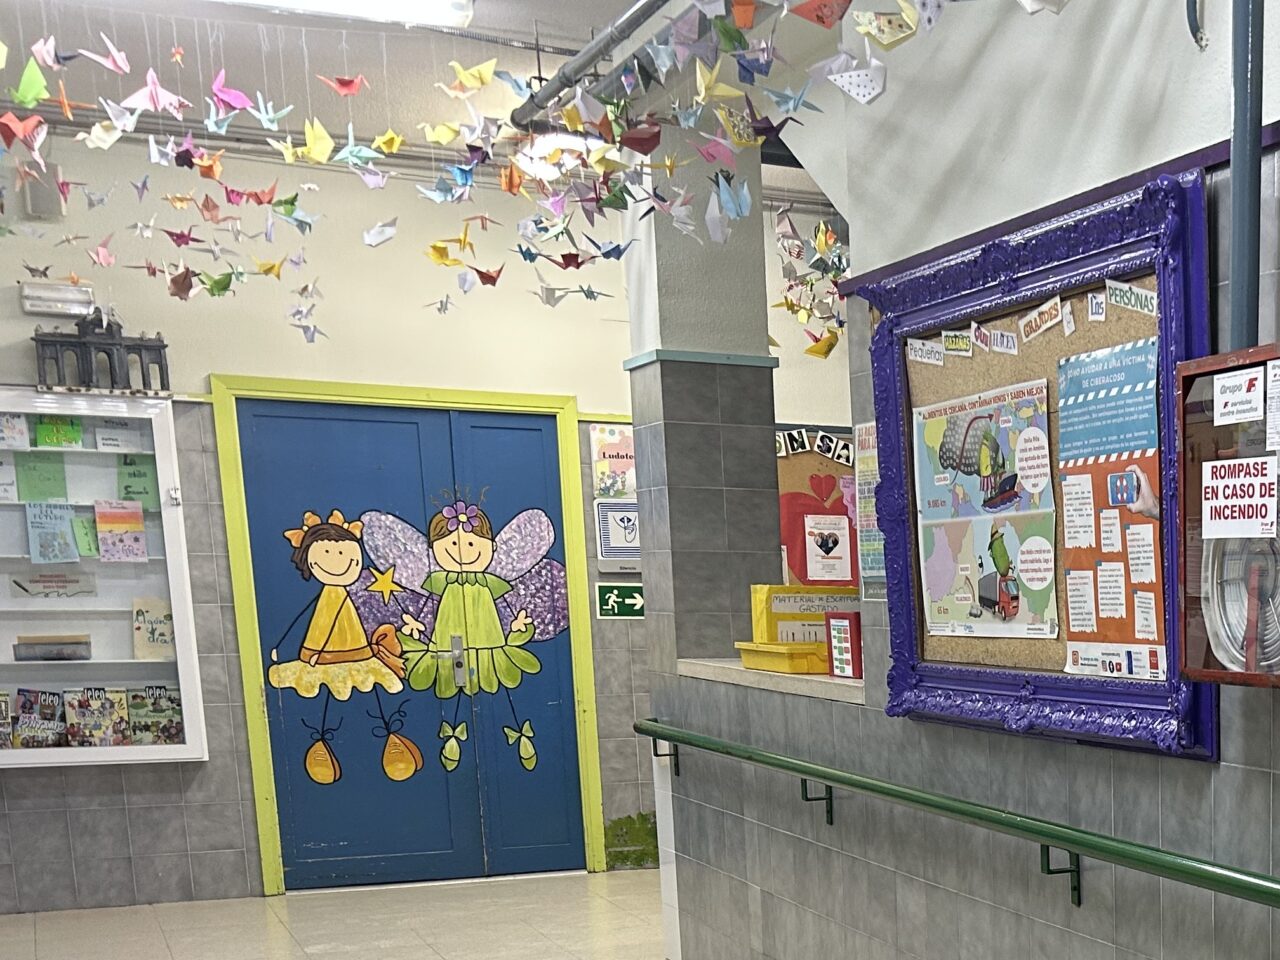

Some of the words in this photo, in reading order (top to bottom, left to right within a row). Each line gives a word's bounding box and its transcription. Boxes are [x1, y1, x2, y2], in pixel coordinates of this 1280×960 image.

[1108, 286, 1155, 314] PERSONAS
[1023, 304, 1060, 339] GRANDES
[909, 342, 944, 362] Pequeñas
[1090, 372, 1126, 386] CIBERACOSO
[1220, 383, 1242, 395] Grupo
[1246, 377, 1258, 394] F
[1010, 390, 1026, 400] SABEN
[1026, 387, 1045, 397] MEJOR
[1211, 462, 1268, 480] ROMPASE
[1204, 486, 1219, 500] EN
[1222, 483, 1255, 500] CASO
[1260, 482, 1276, 498] DE
[1210, 504, 1268, 520] INCENDIO
[773, 595, 816, 604] MATERIAL
[798, 604, 838, 613] GASTADO
